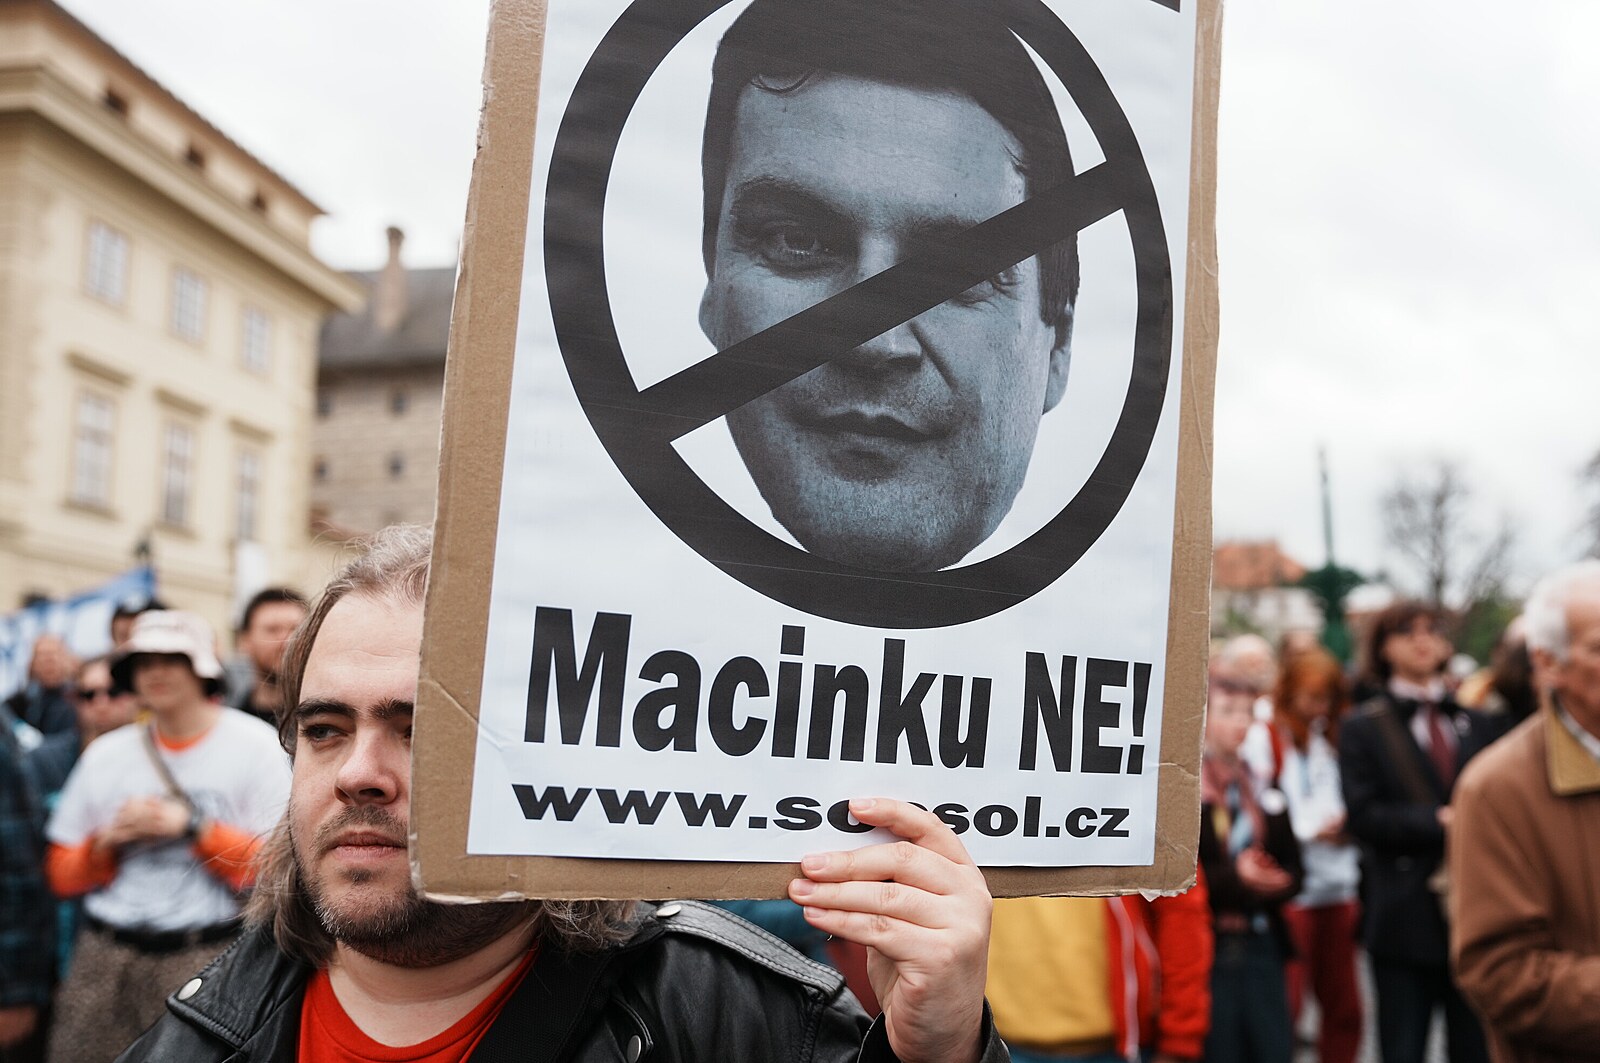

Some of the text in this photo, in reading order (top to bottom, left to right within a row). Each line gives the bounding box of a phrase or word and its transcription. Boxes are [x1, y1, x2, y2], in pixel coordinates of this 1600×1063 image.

[523, 605, 1153, 775] Macinku NE!
[511, 783, 1130, 839] www.sosol.cz
